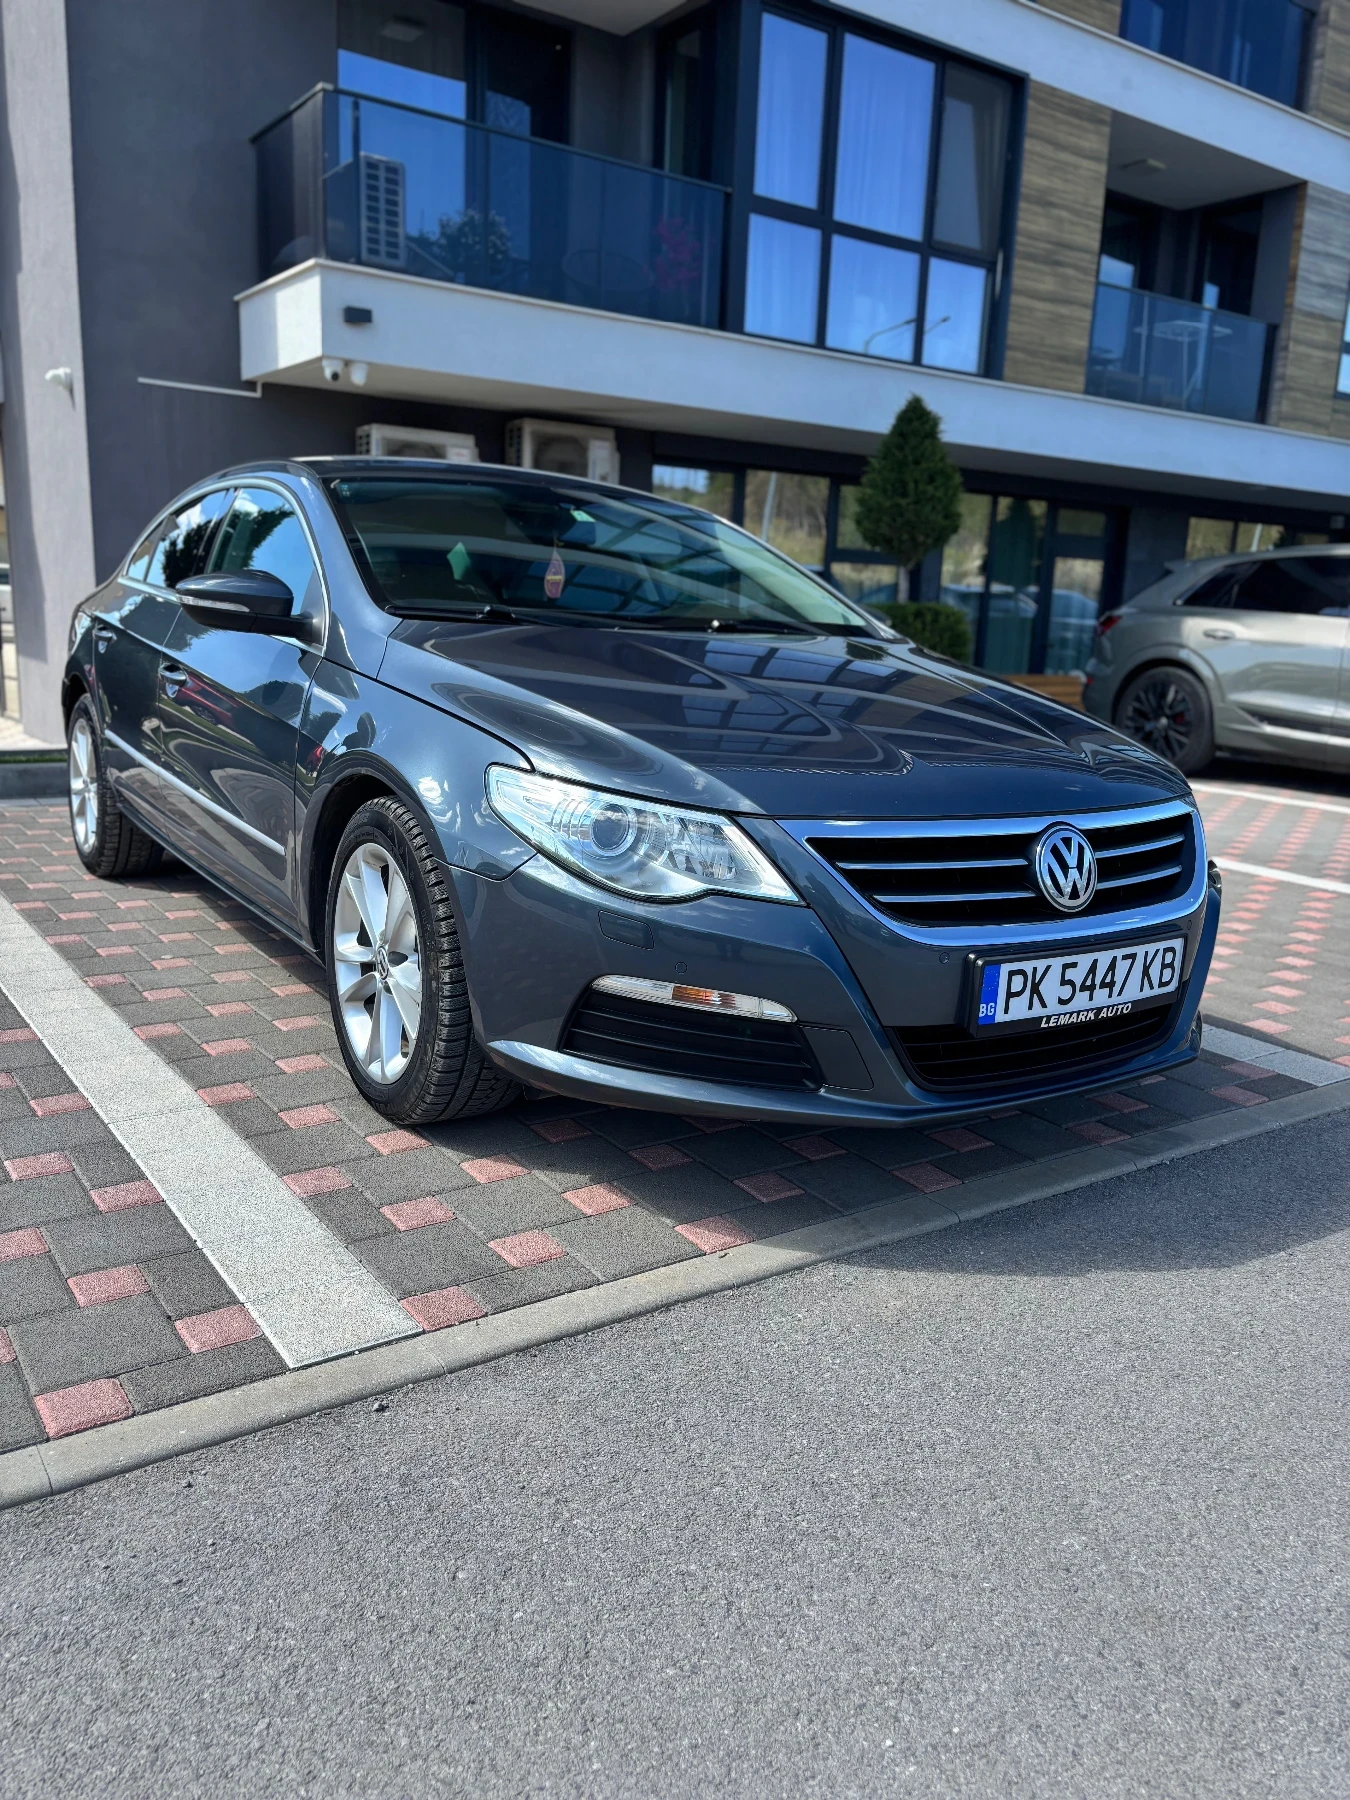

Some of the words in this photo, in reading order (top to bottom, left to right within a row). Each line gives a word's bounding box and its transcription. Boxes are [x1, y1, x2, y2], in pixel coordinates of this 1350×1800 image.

[1042, 832, 1095, 904] VW
[1003, 964, 1052, 1015] PK
[1057, 951, 1137, 1006] 5447
[1139, 946, 1177, 993] KB
[979, 1003, 995, 1017] BG
[1041, 1009, 1096, 1028] LEMARK
[1099, 1003, 1132, 1019] AUTO
